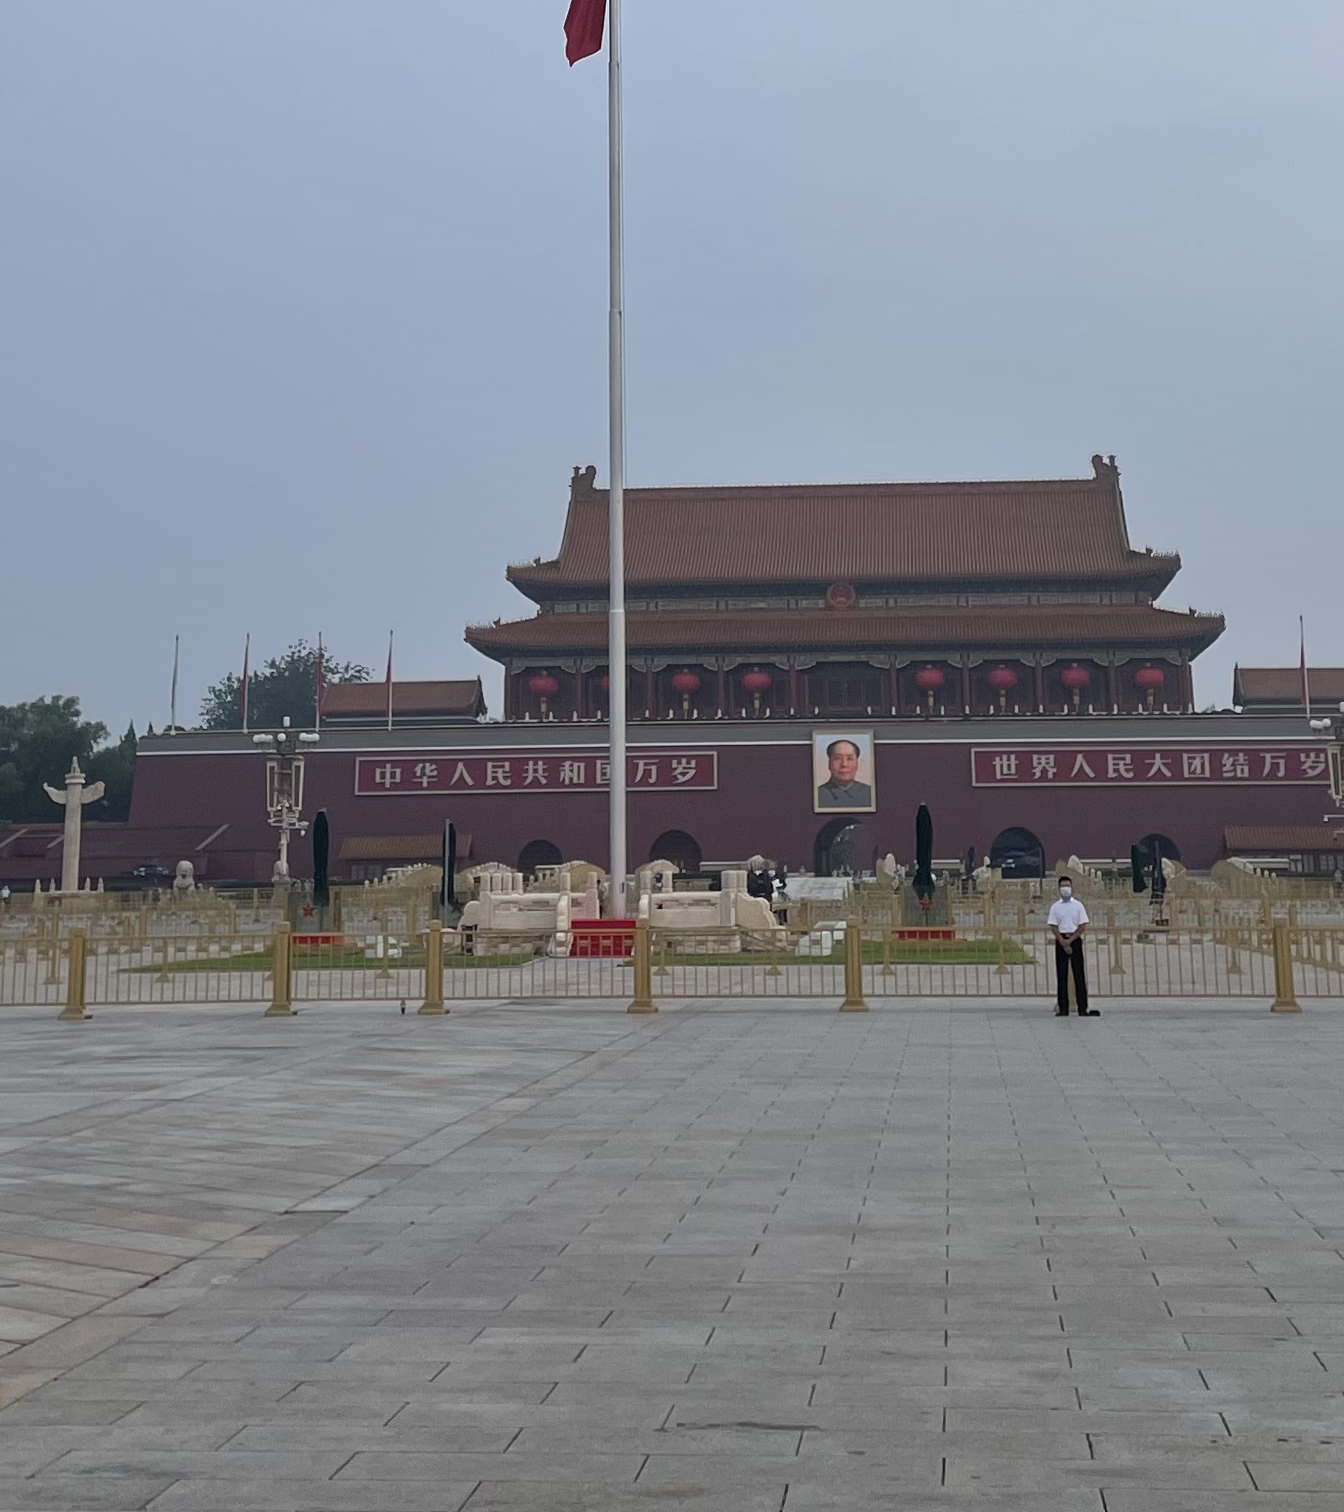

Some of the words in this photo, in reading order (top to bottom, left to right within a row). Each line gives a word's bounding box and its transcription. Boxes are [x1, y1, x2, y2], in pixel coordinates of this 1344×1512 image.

[992, 752, 1327, 780] 世界人民大团结万岁
